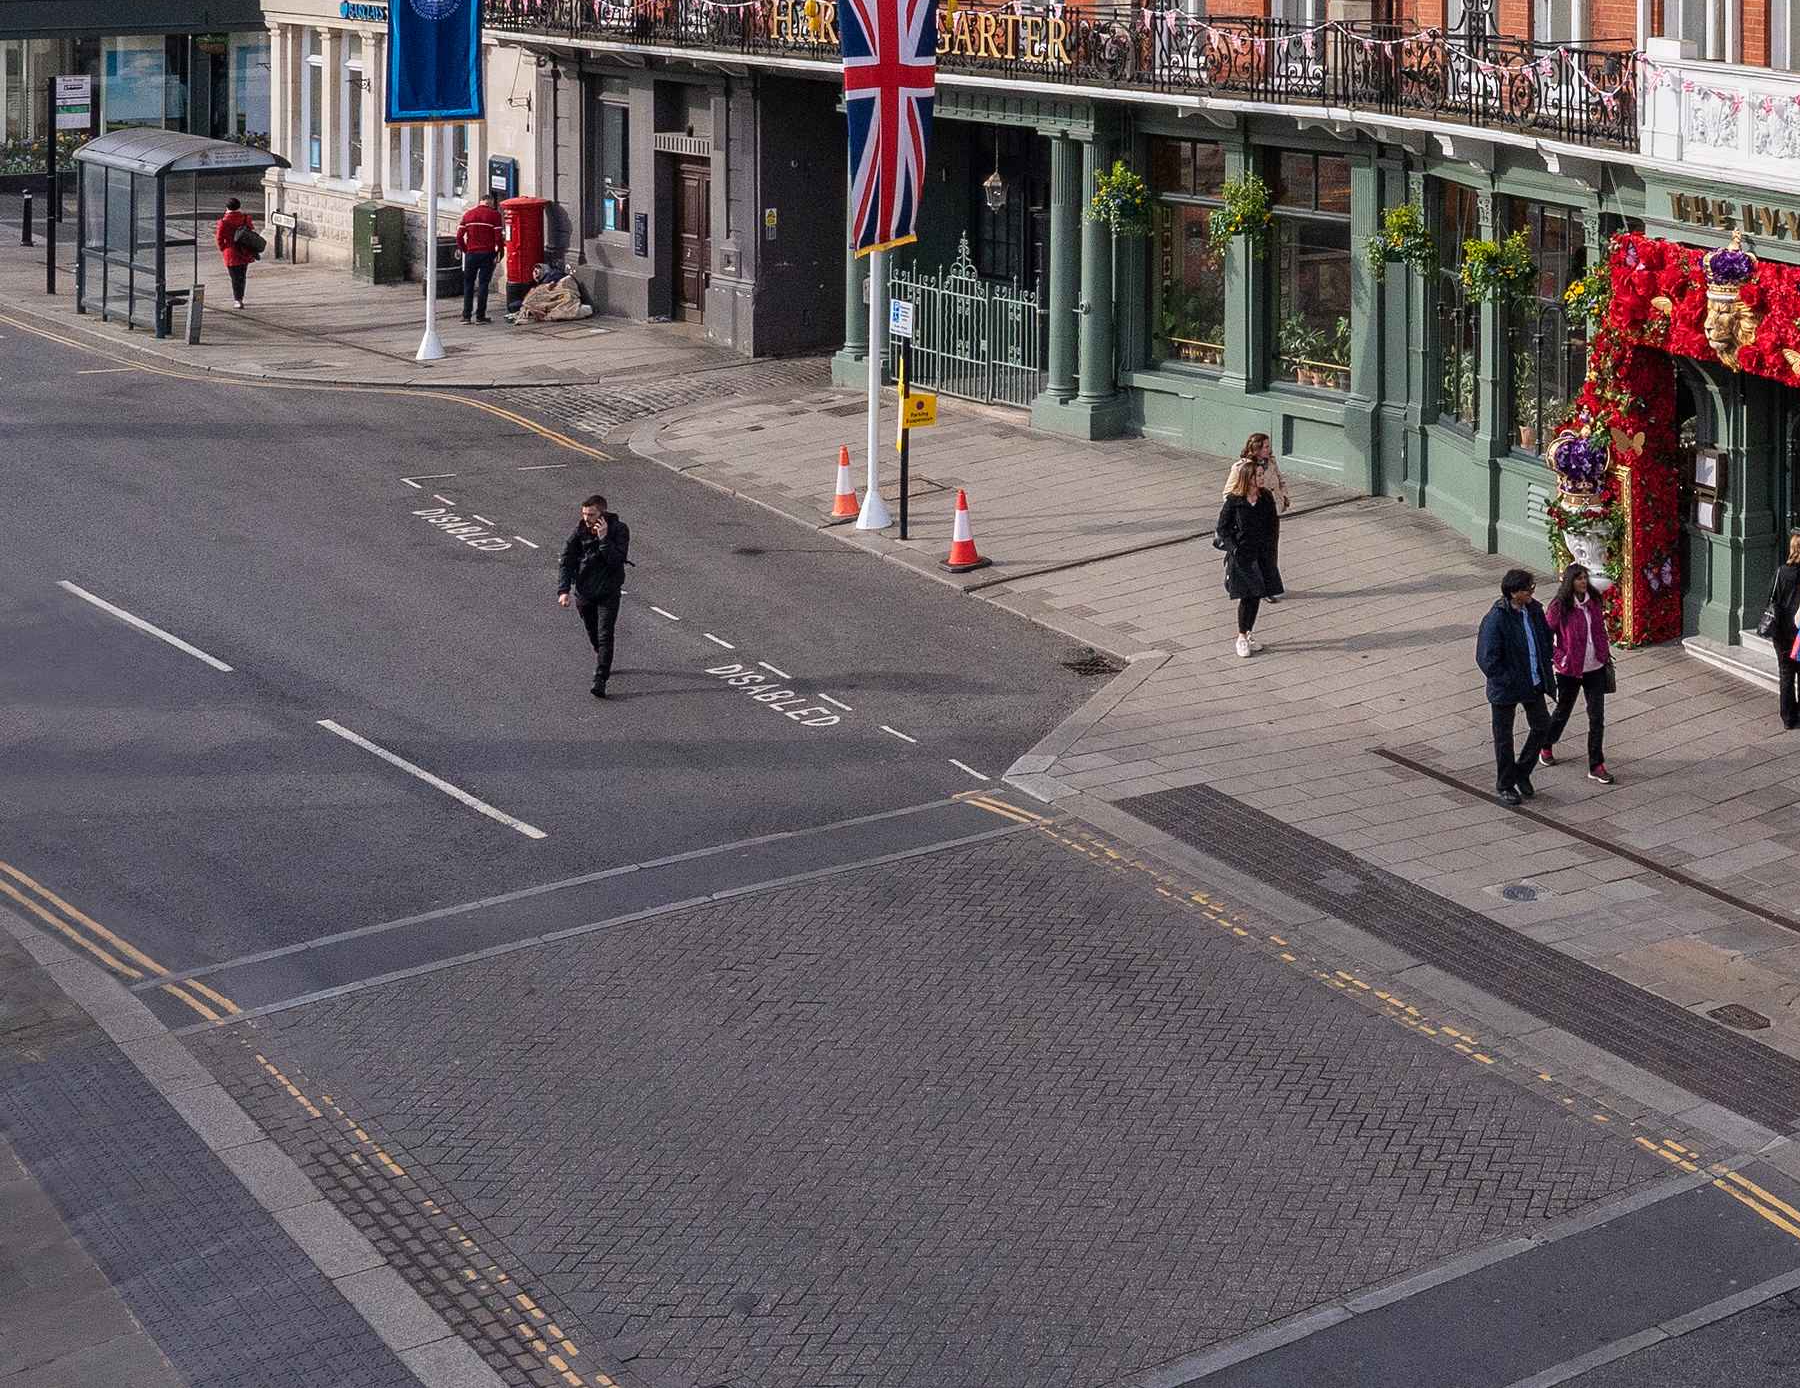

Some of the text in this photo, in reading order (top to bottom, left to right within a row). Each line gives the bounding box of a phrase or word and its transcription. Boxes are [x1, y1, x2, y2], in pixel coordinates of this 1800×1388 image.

[935, 8, 1072, 65] GARTER
[1667, 190, 1732, 230] THE
[412, 508, 513, 551] DISABLED
[704, 663, 841, 727] DISABLED
